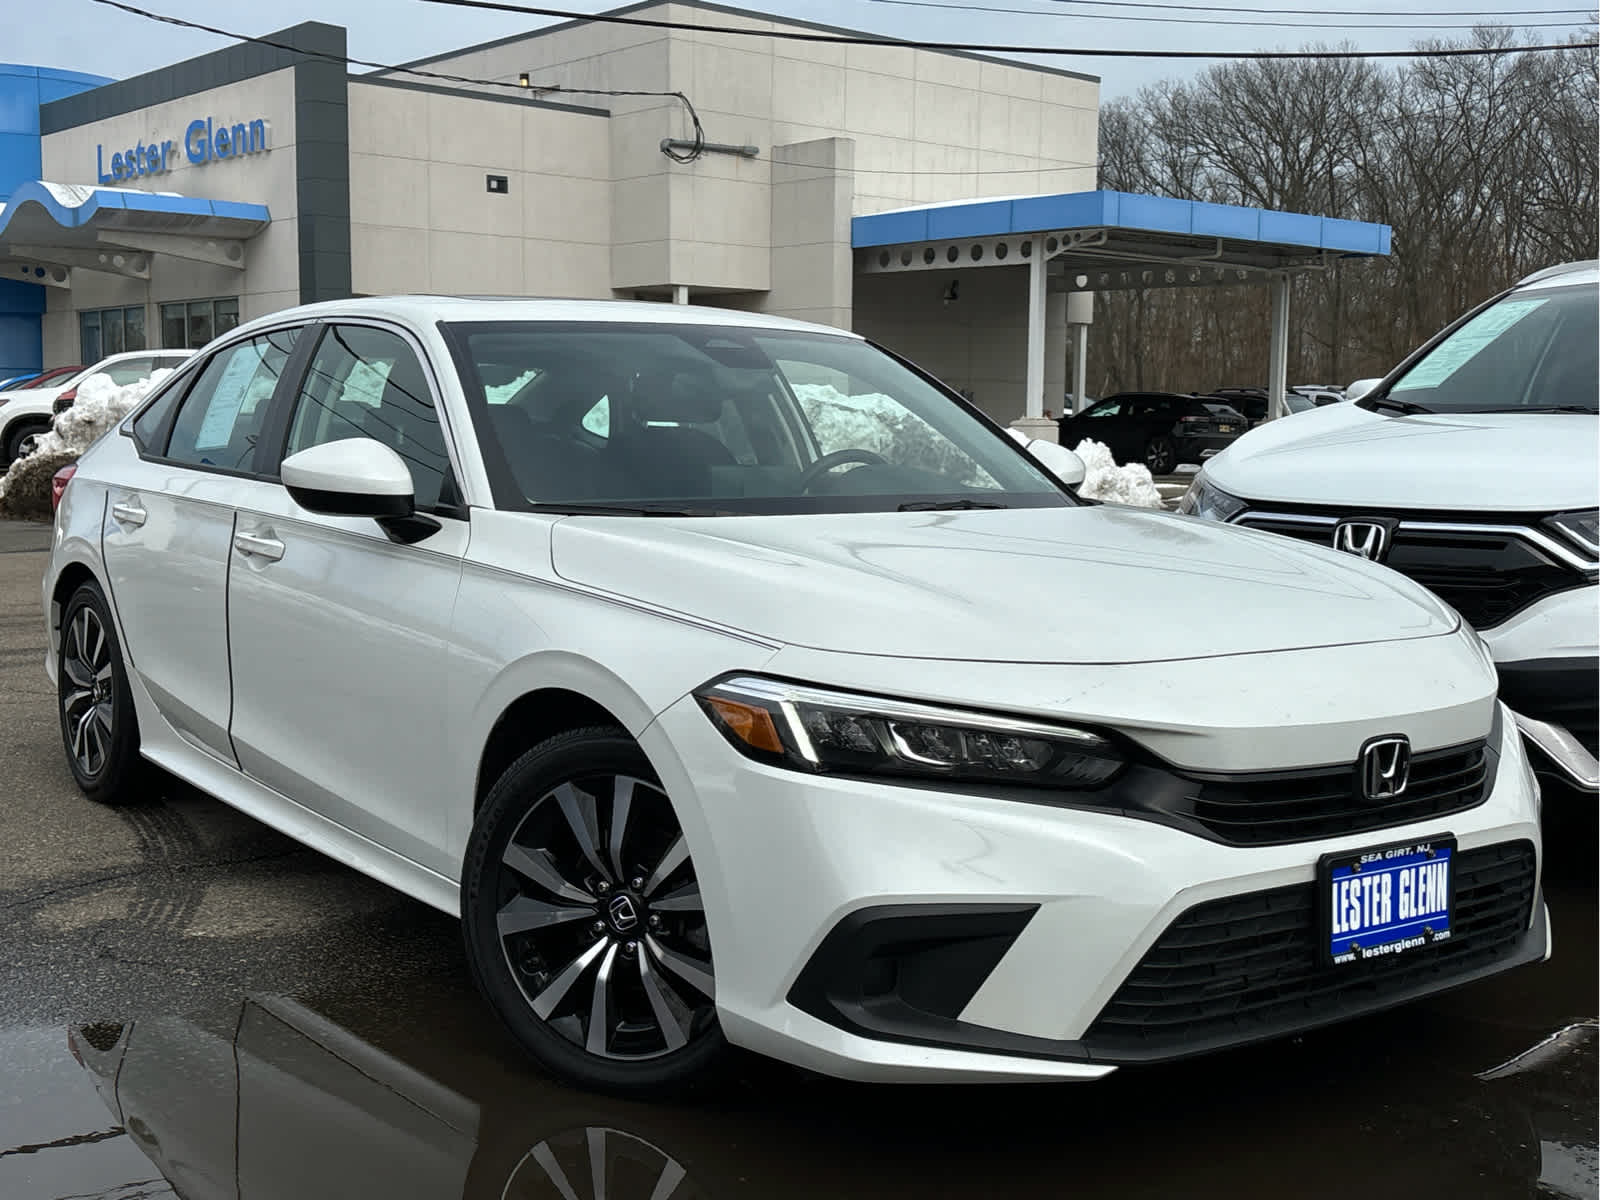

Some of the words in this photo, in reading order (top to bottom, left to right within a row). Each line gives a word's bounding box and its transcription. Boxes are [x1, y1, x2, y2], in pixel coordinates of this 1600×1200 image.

[97, 140, 172, 184] Lester
[185, 116, 265, 164] Glenn
[1360, 852, 1383, 864] SEA
[1385, 847, 1414, 859] GIRT,
[1416, 843, 1431, 853] NJ
[1332, 872, 1392, 934] LESTER
[1399, 862, 1448, 920] GLENN
[1362, 936, 1425, 959] lesterglenn
